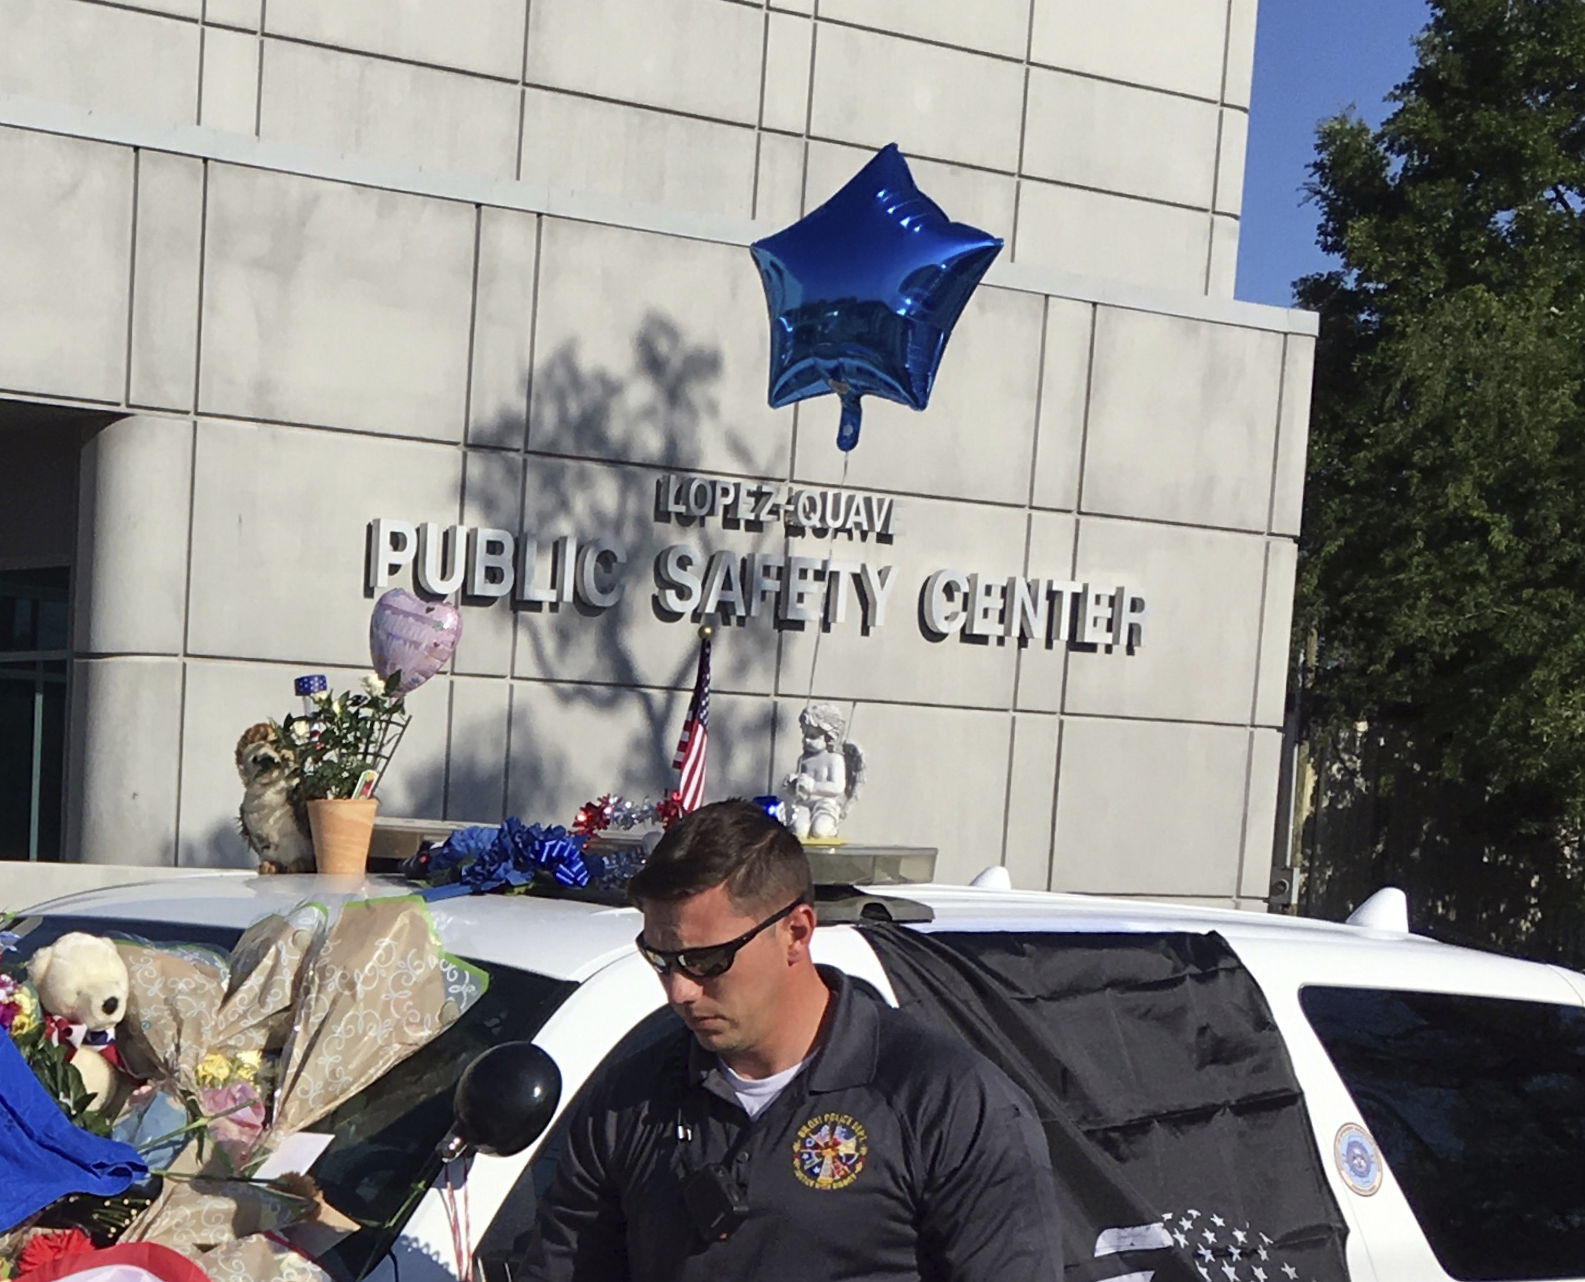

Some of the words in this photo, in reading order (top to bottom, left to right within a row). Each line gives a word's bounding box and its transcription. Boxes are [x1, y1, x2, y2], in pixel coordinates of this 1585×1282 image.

[370, 518, 628, 608] PUBLIC
[657, 544, 898, 627] SAFETY
[924, 569, 1150, 647] CENTER
